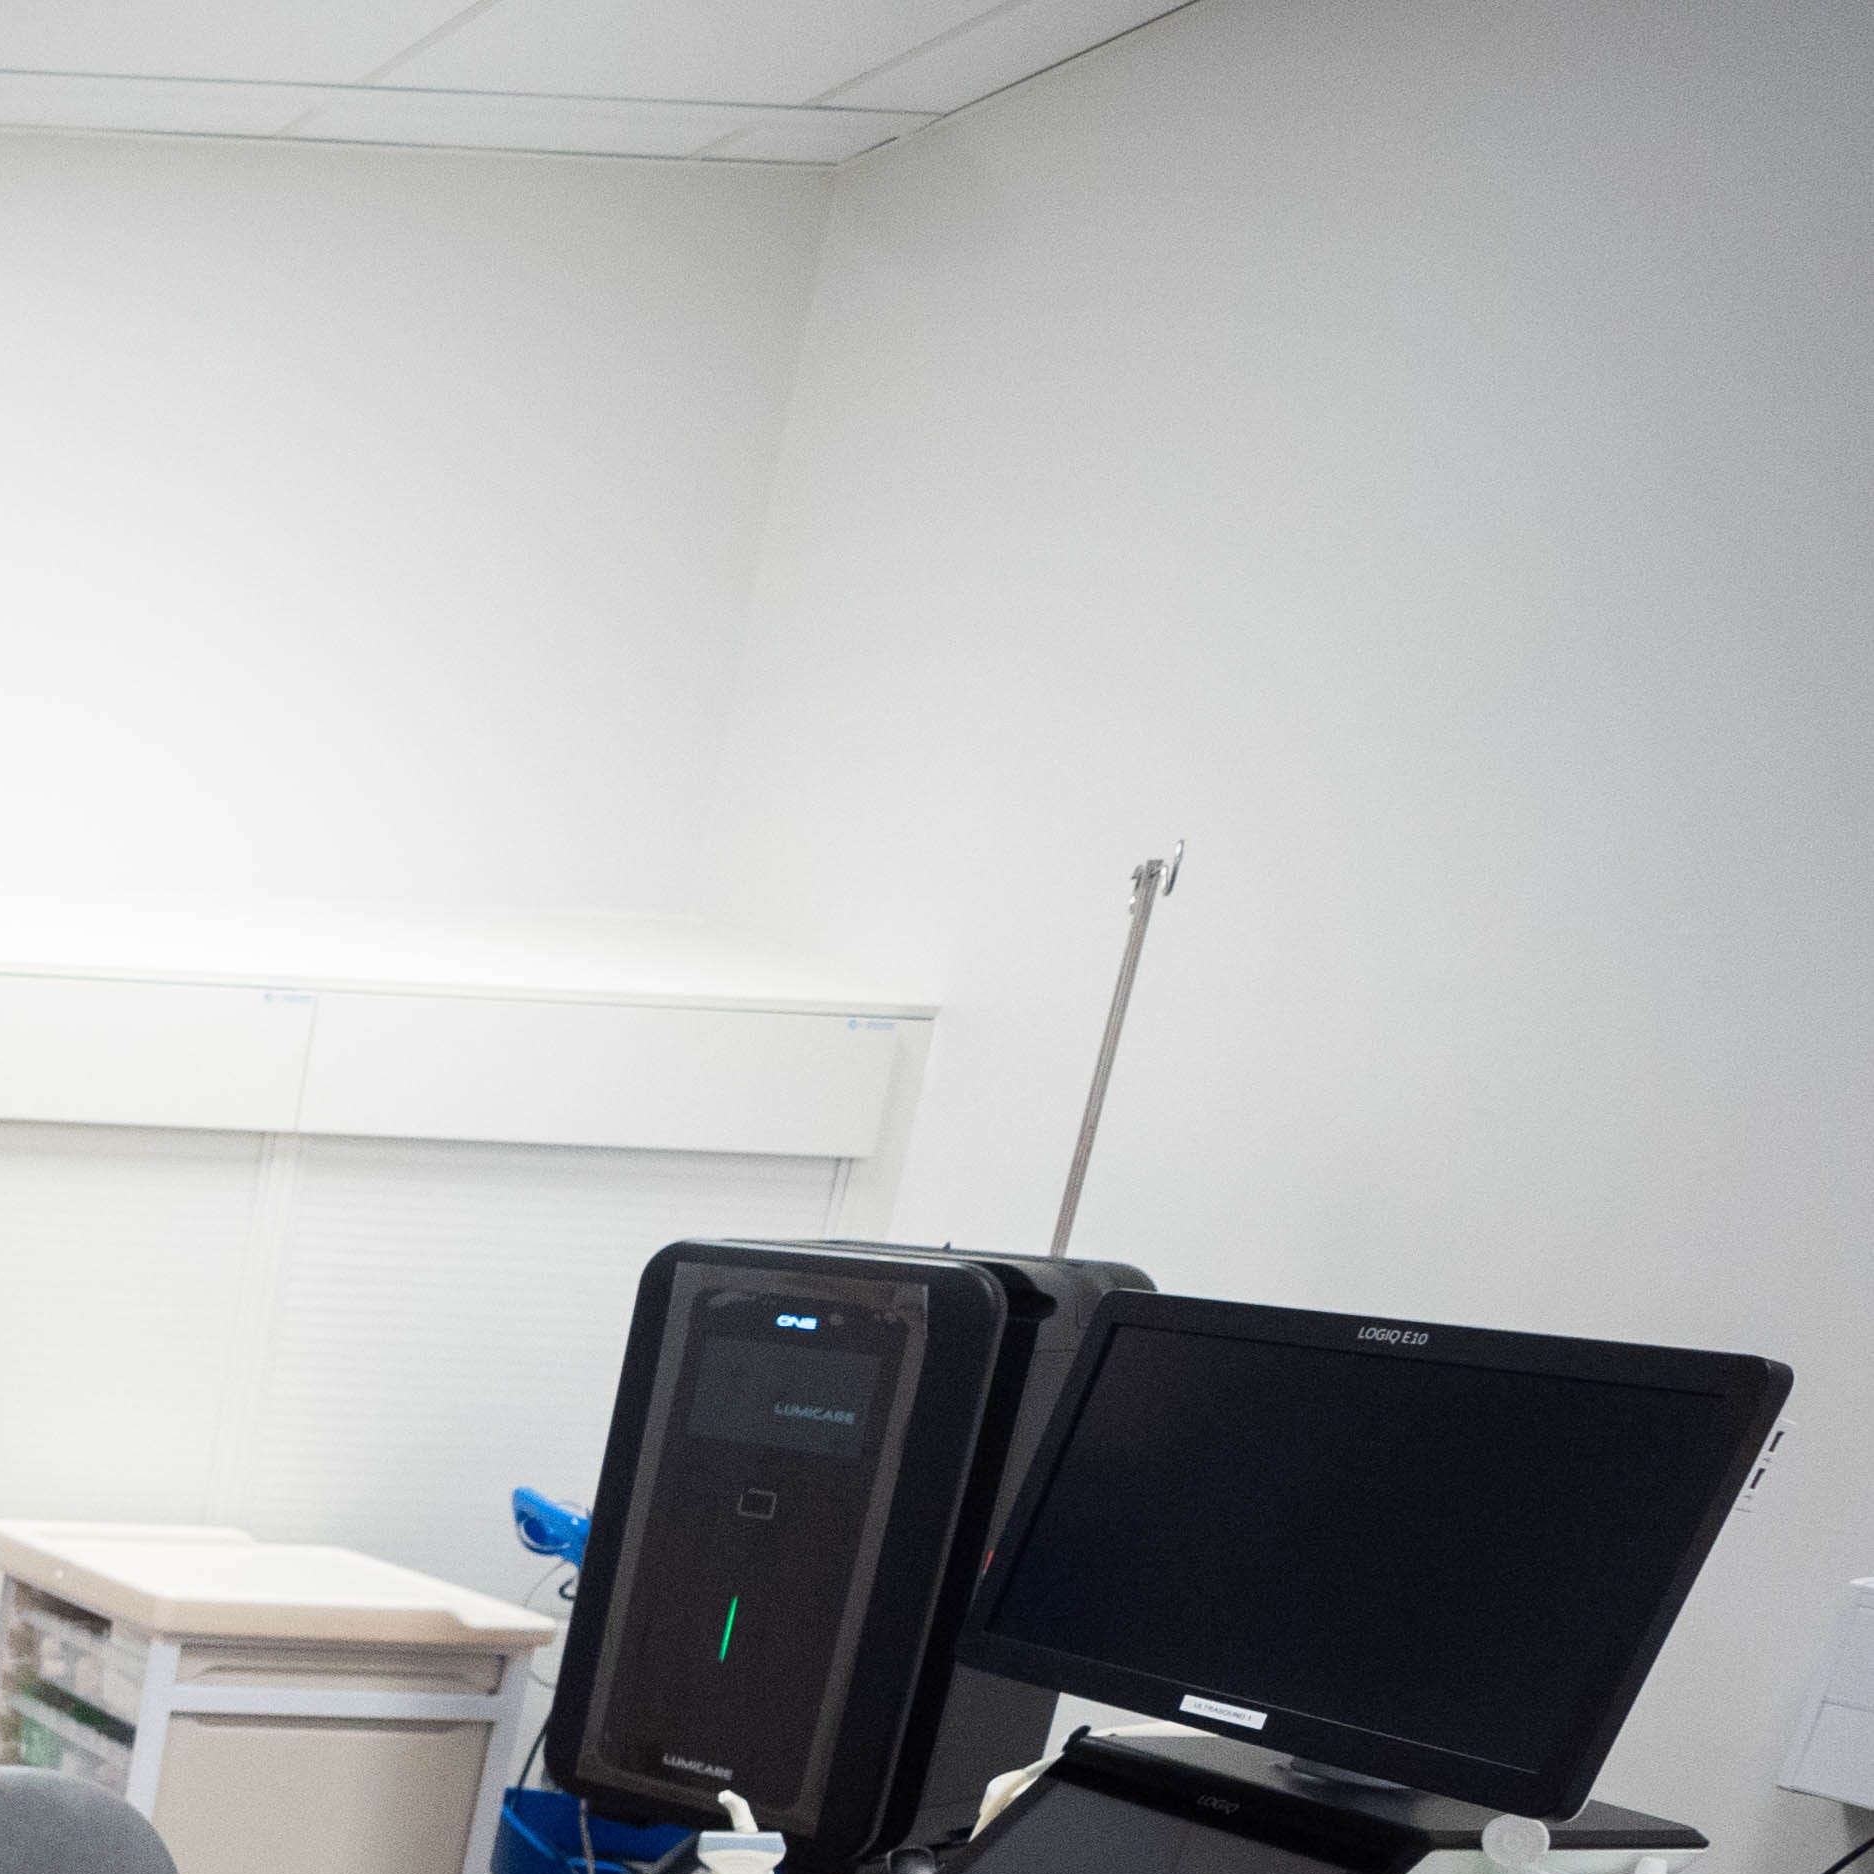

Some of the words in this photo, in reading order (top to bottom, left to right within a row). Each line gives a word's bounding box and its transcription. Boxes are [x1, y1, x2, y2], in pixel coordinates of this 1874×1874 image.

[776, 1313, 818, 1331] ONE
[1357, 1326, 1401, 1345] LOGIQ
[1401, 1330, 1429, 1345] E10
[774, 1402, 856, 1425] LUMICARE
[662, 1752, 733, 1780] LUMICARE
[1196, 1795, 1240, 1815] LOGIQ
